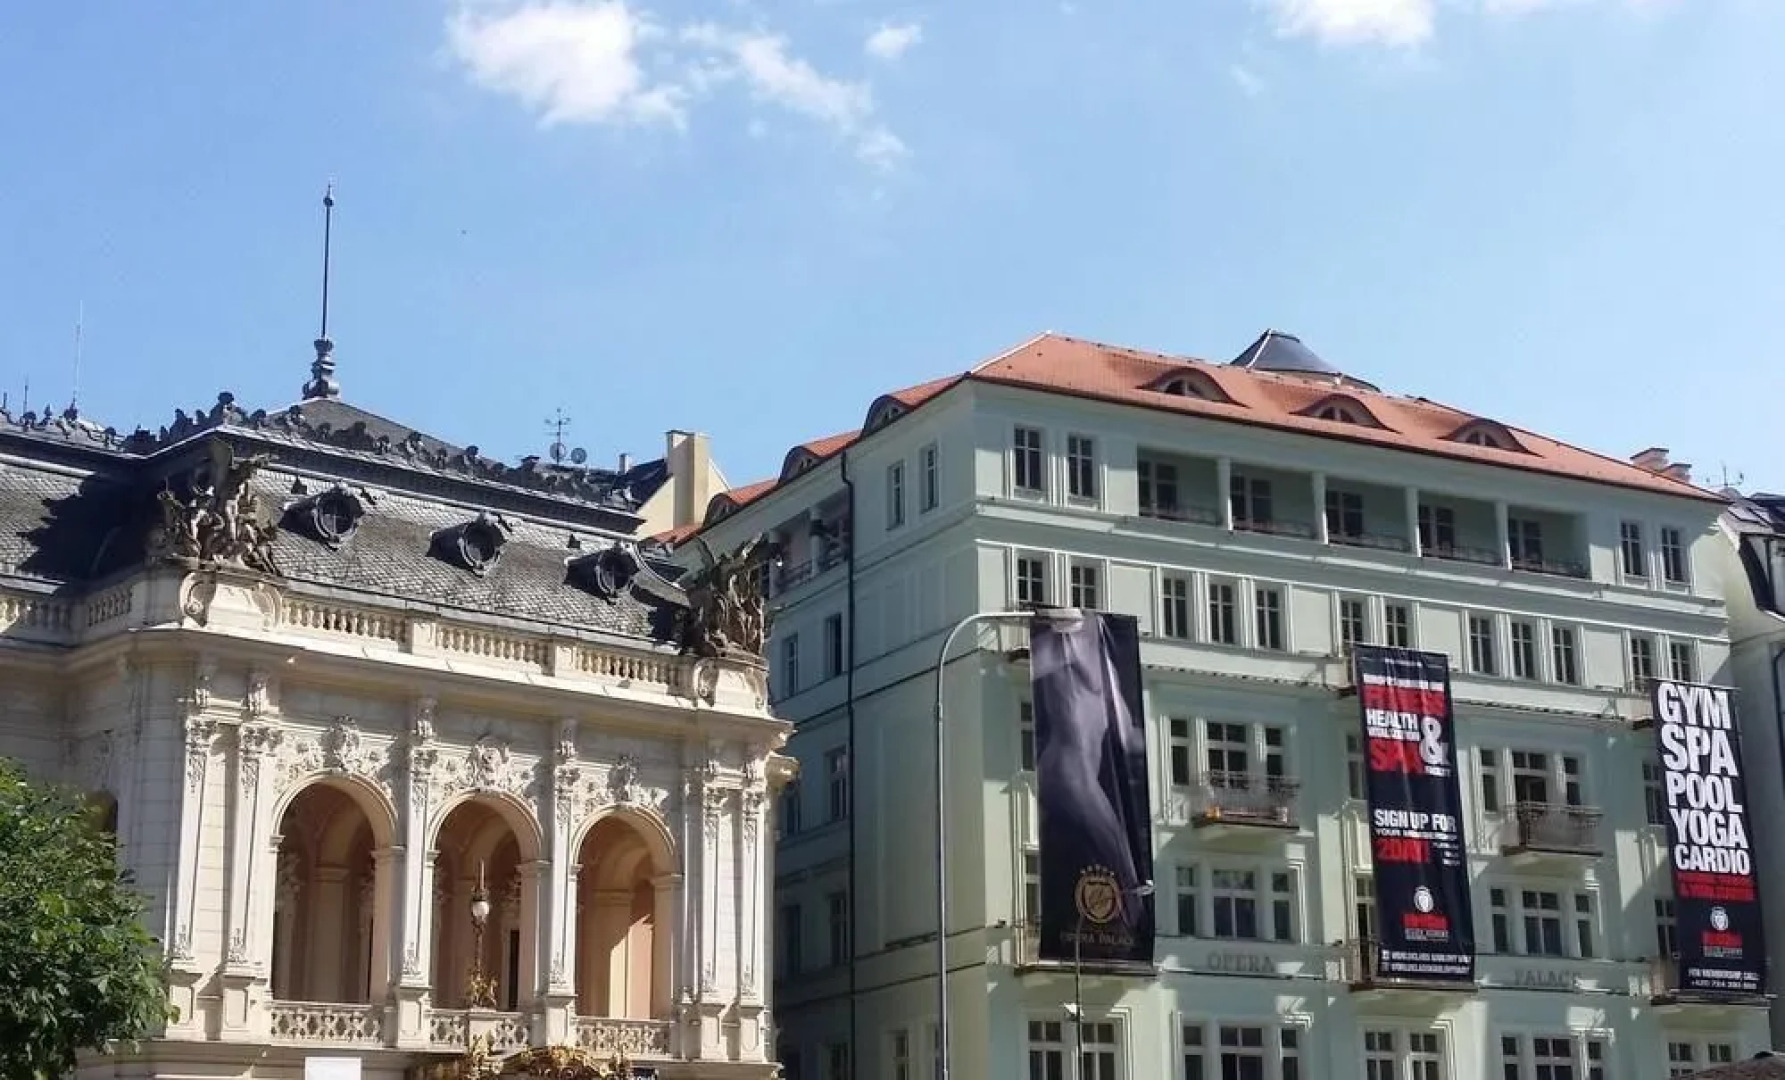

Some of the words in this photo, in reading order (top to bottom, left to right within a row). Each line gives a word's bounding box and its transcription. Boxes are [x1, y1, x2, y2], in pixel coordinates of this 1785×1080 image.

[1658, 682, 1732, 729] GYM
[1366, 708, 1418, 731] HEALTH
[1421, 716, 1448, 765] &
[1662, 724, 1740, 776] SPA
[1665, 771, 1743, 813] POOL
[1374, 808, 1409, 828] SIGN
[1410, 812, 1429, 830] UP
[1431, 814, 1457, 833] FOR
[1669, 808, 1749, 849] YOGA
[1674, 844, 1750, 875] CARDIO
[1207, 951, 1276, 973] OPERA
